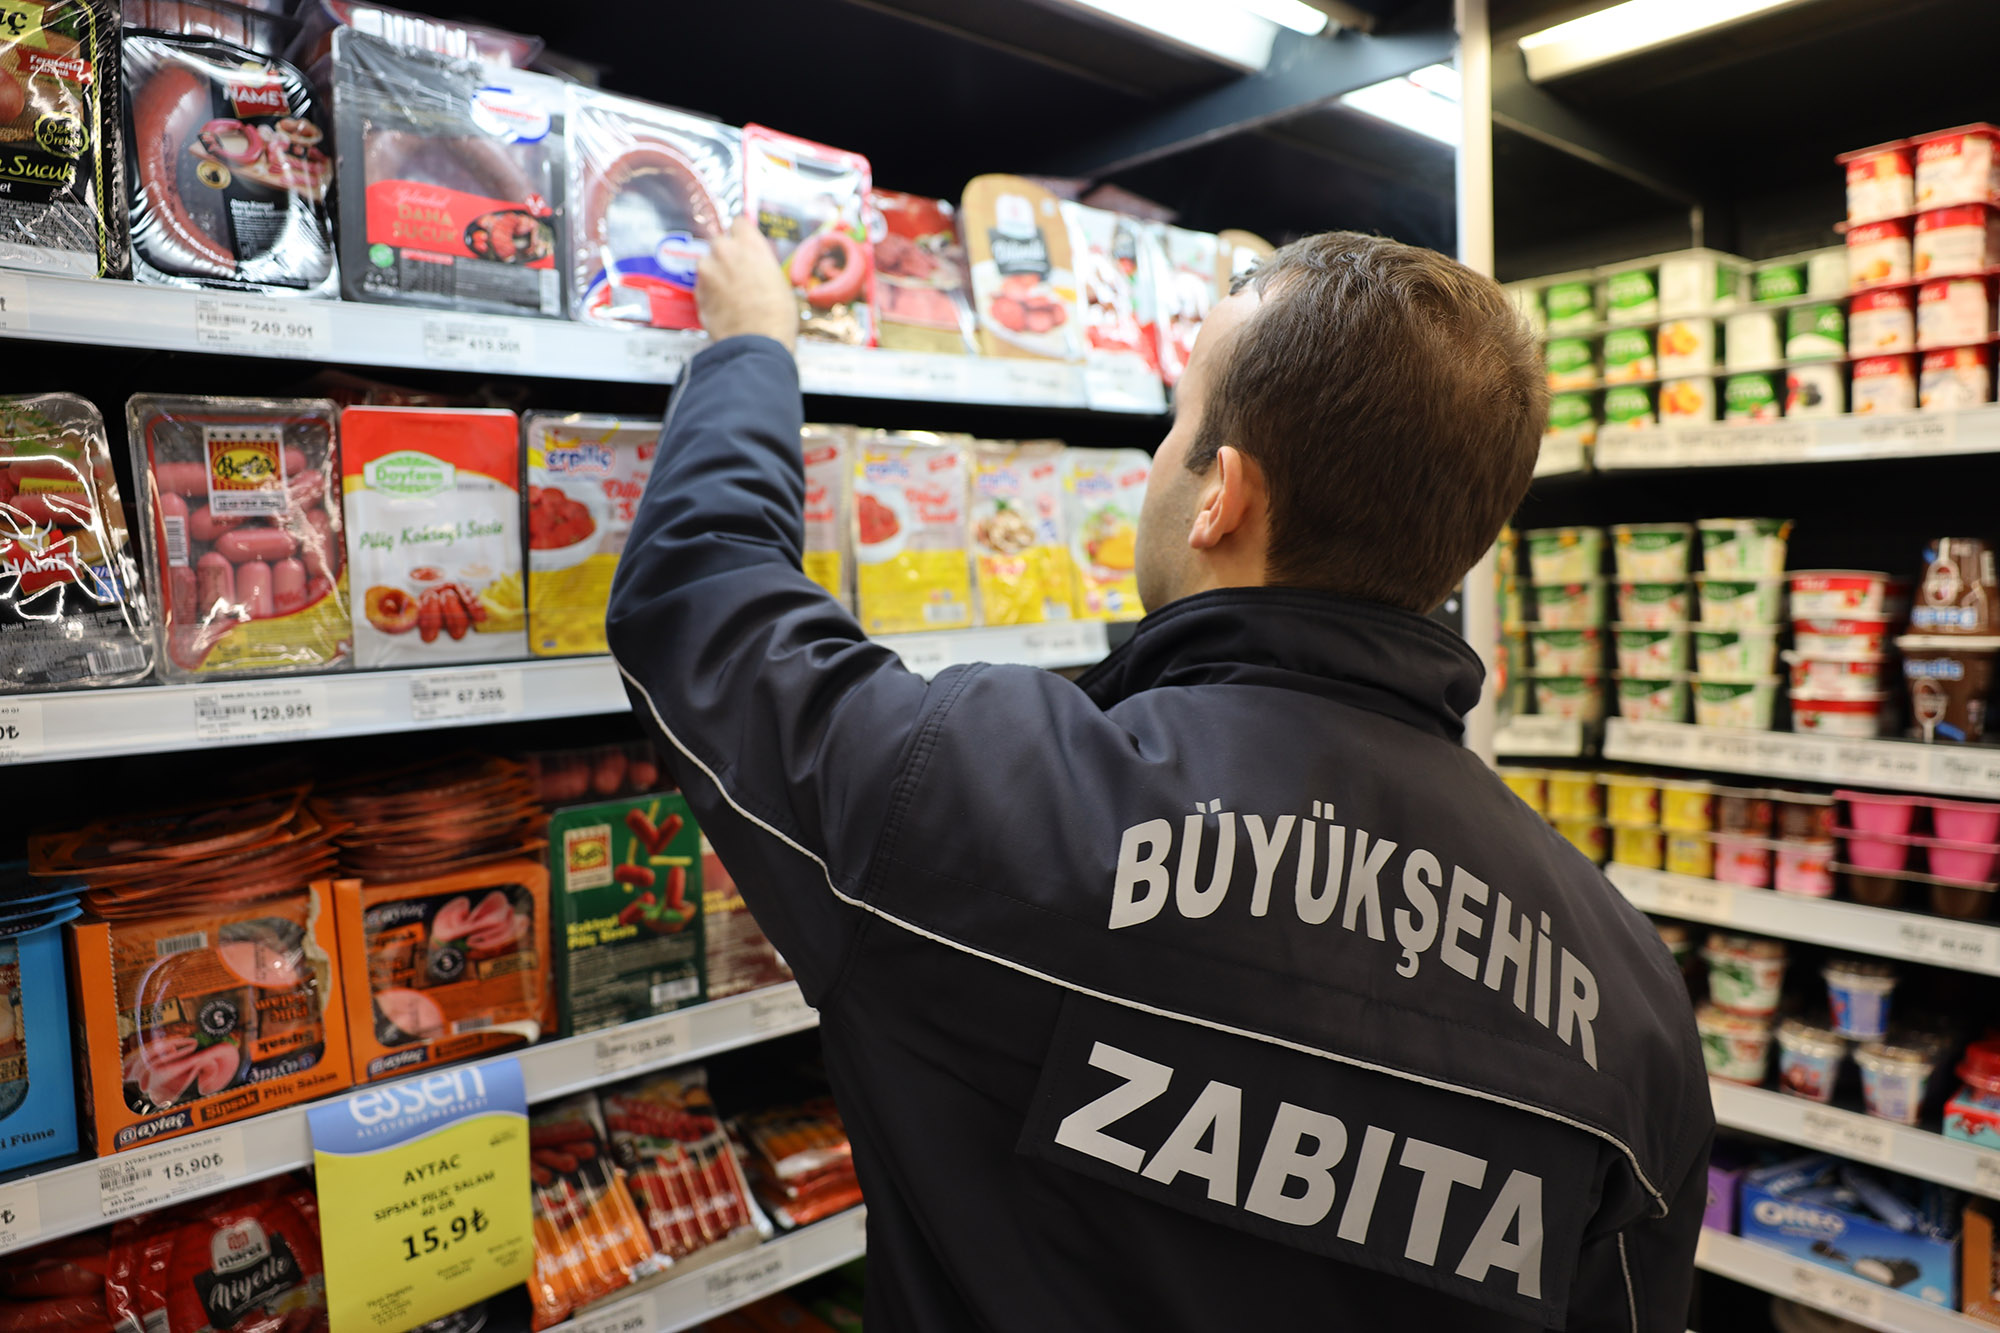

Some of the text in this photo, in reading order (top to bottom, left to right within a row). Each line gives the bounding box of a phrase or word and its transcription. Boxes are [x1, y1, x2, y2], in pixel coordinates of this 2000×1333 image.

[2, 552, 81, 576] NAMET
[1108, 798, 1600, 1072] BÜYÜKŞEHİR
[349, 1066, 487, 1125] essen
[1054, 1041, 1544, 1300] ZABITA
